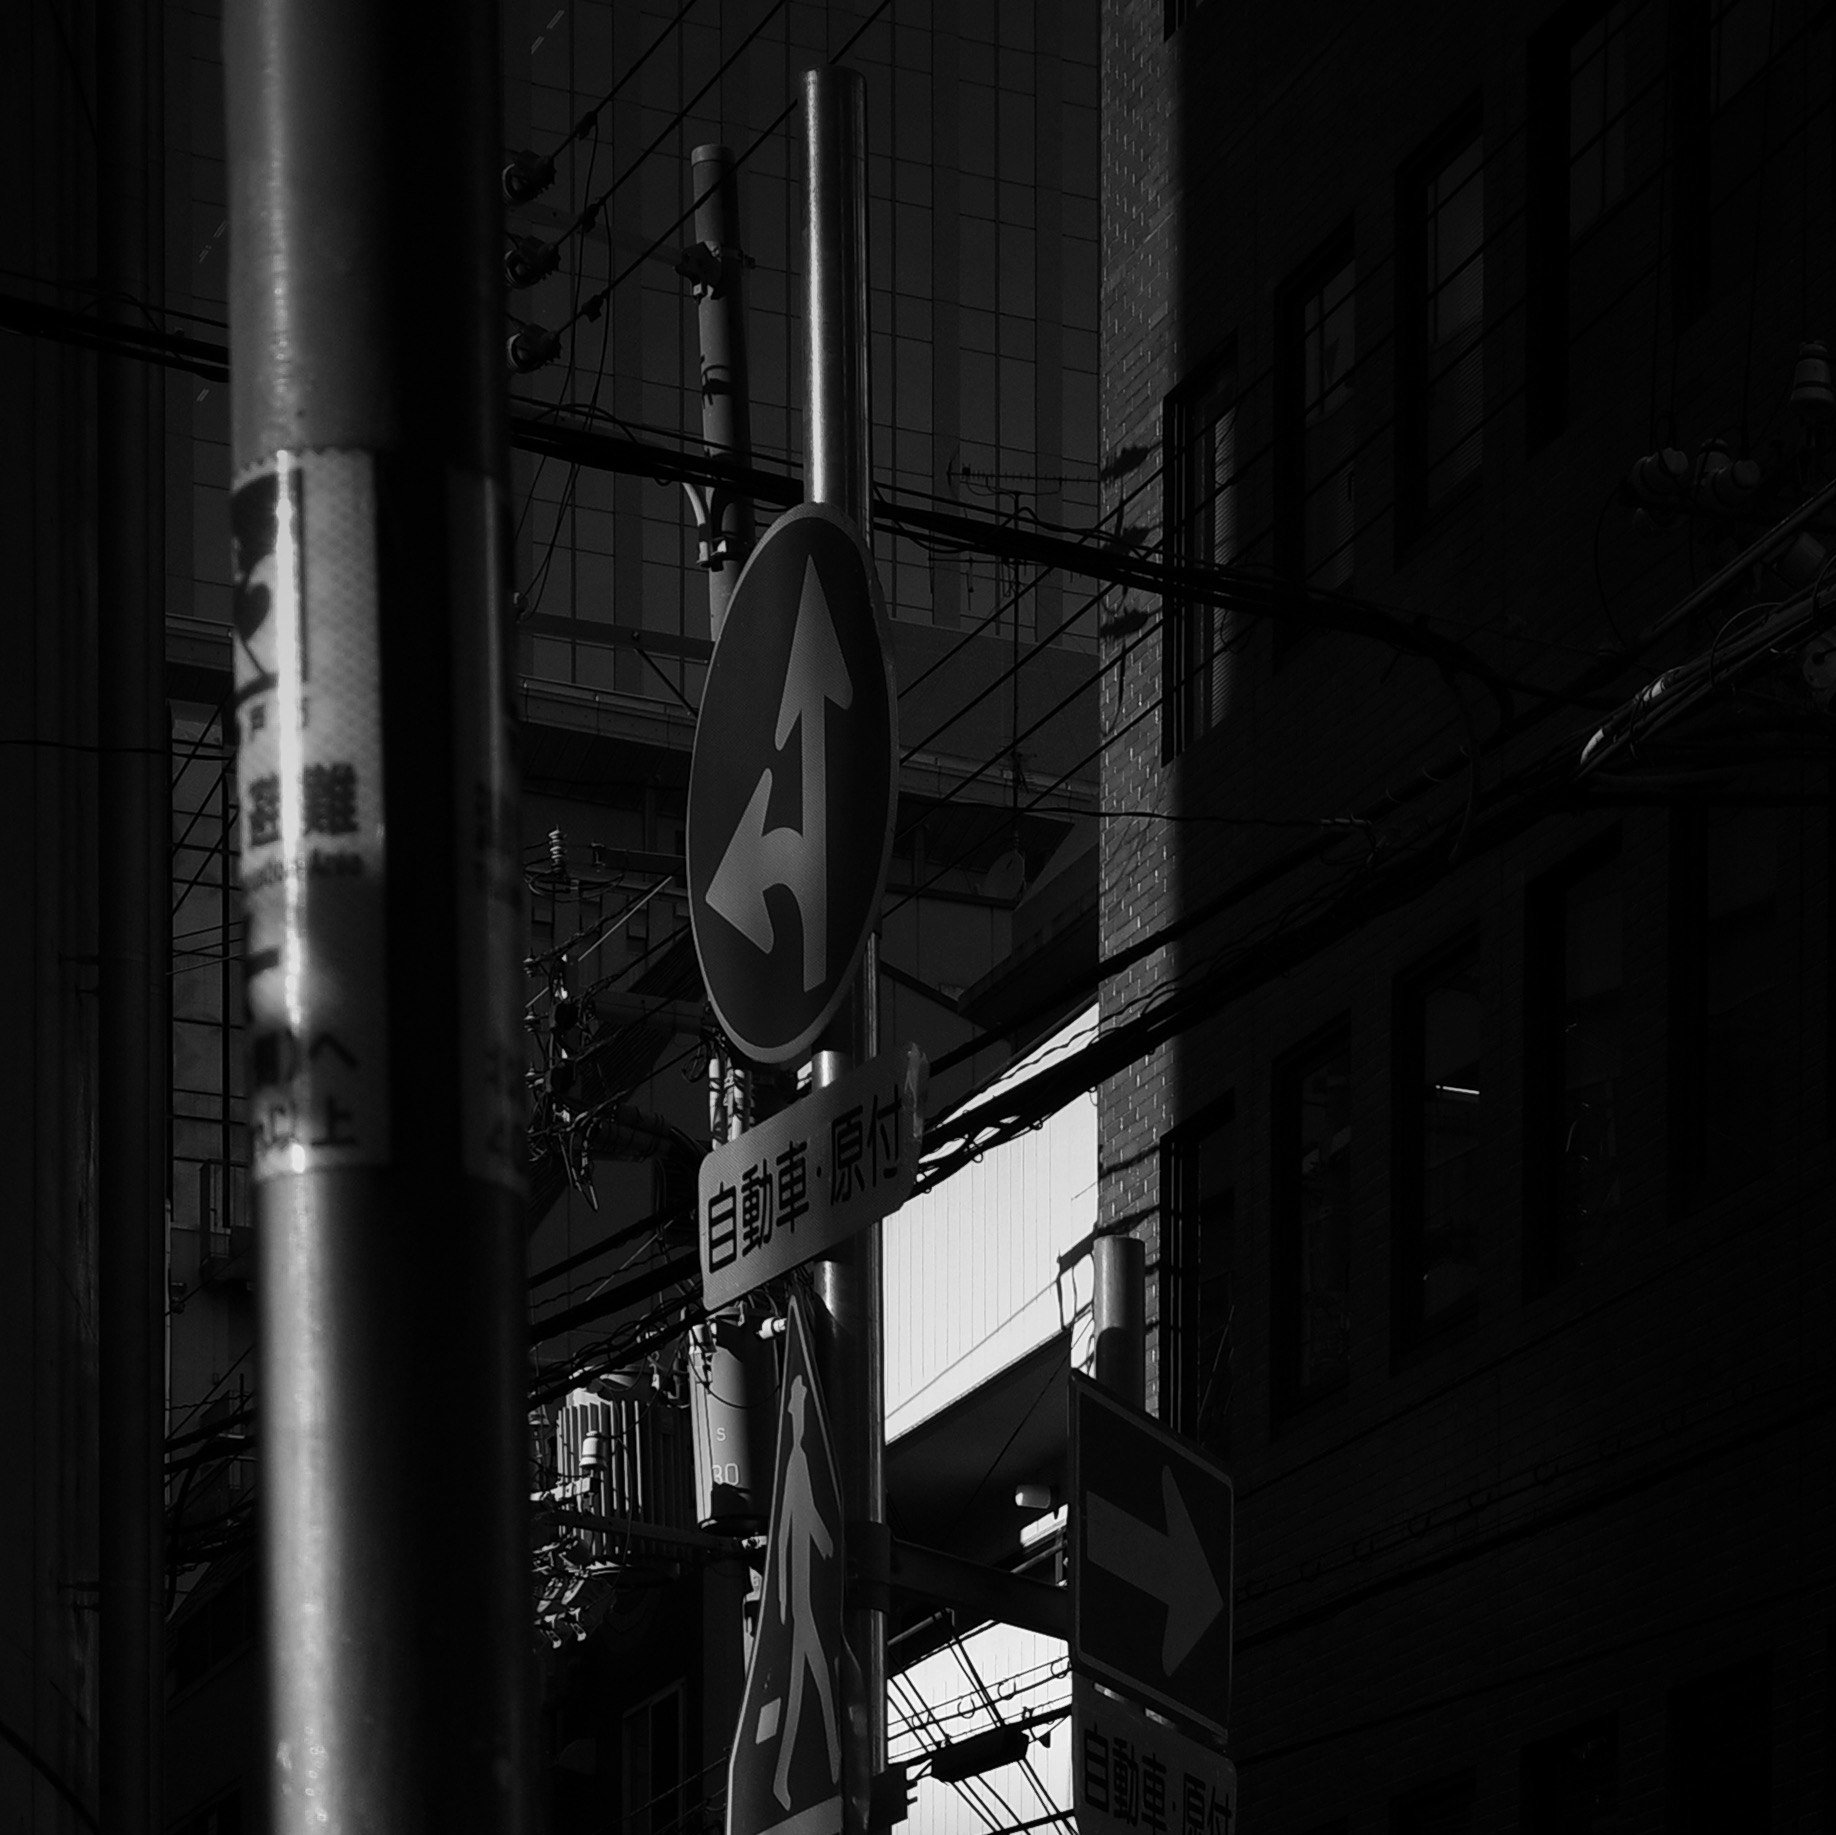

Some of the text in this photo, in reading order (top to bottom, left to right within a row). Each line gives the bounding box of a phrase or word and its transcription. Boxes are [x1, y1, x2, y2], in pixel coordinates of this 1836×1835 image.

[708, 1083, 902, 1274] 自動車・原付
